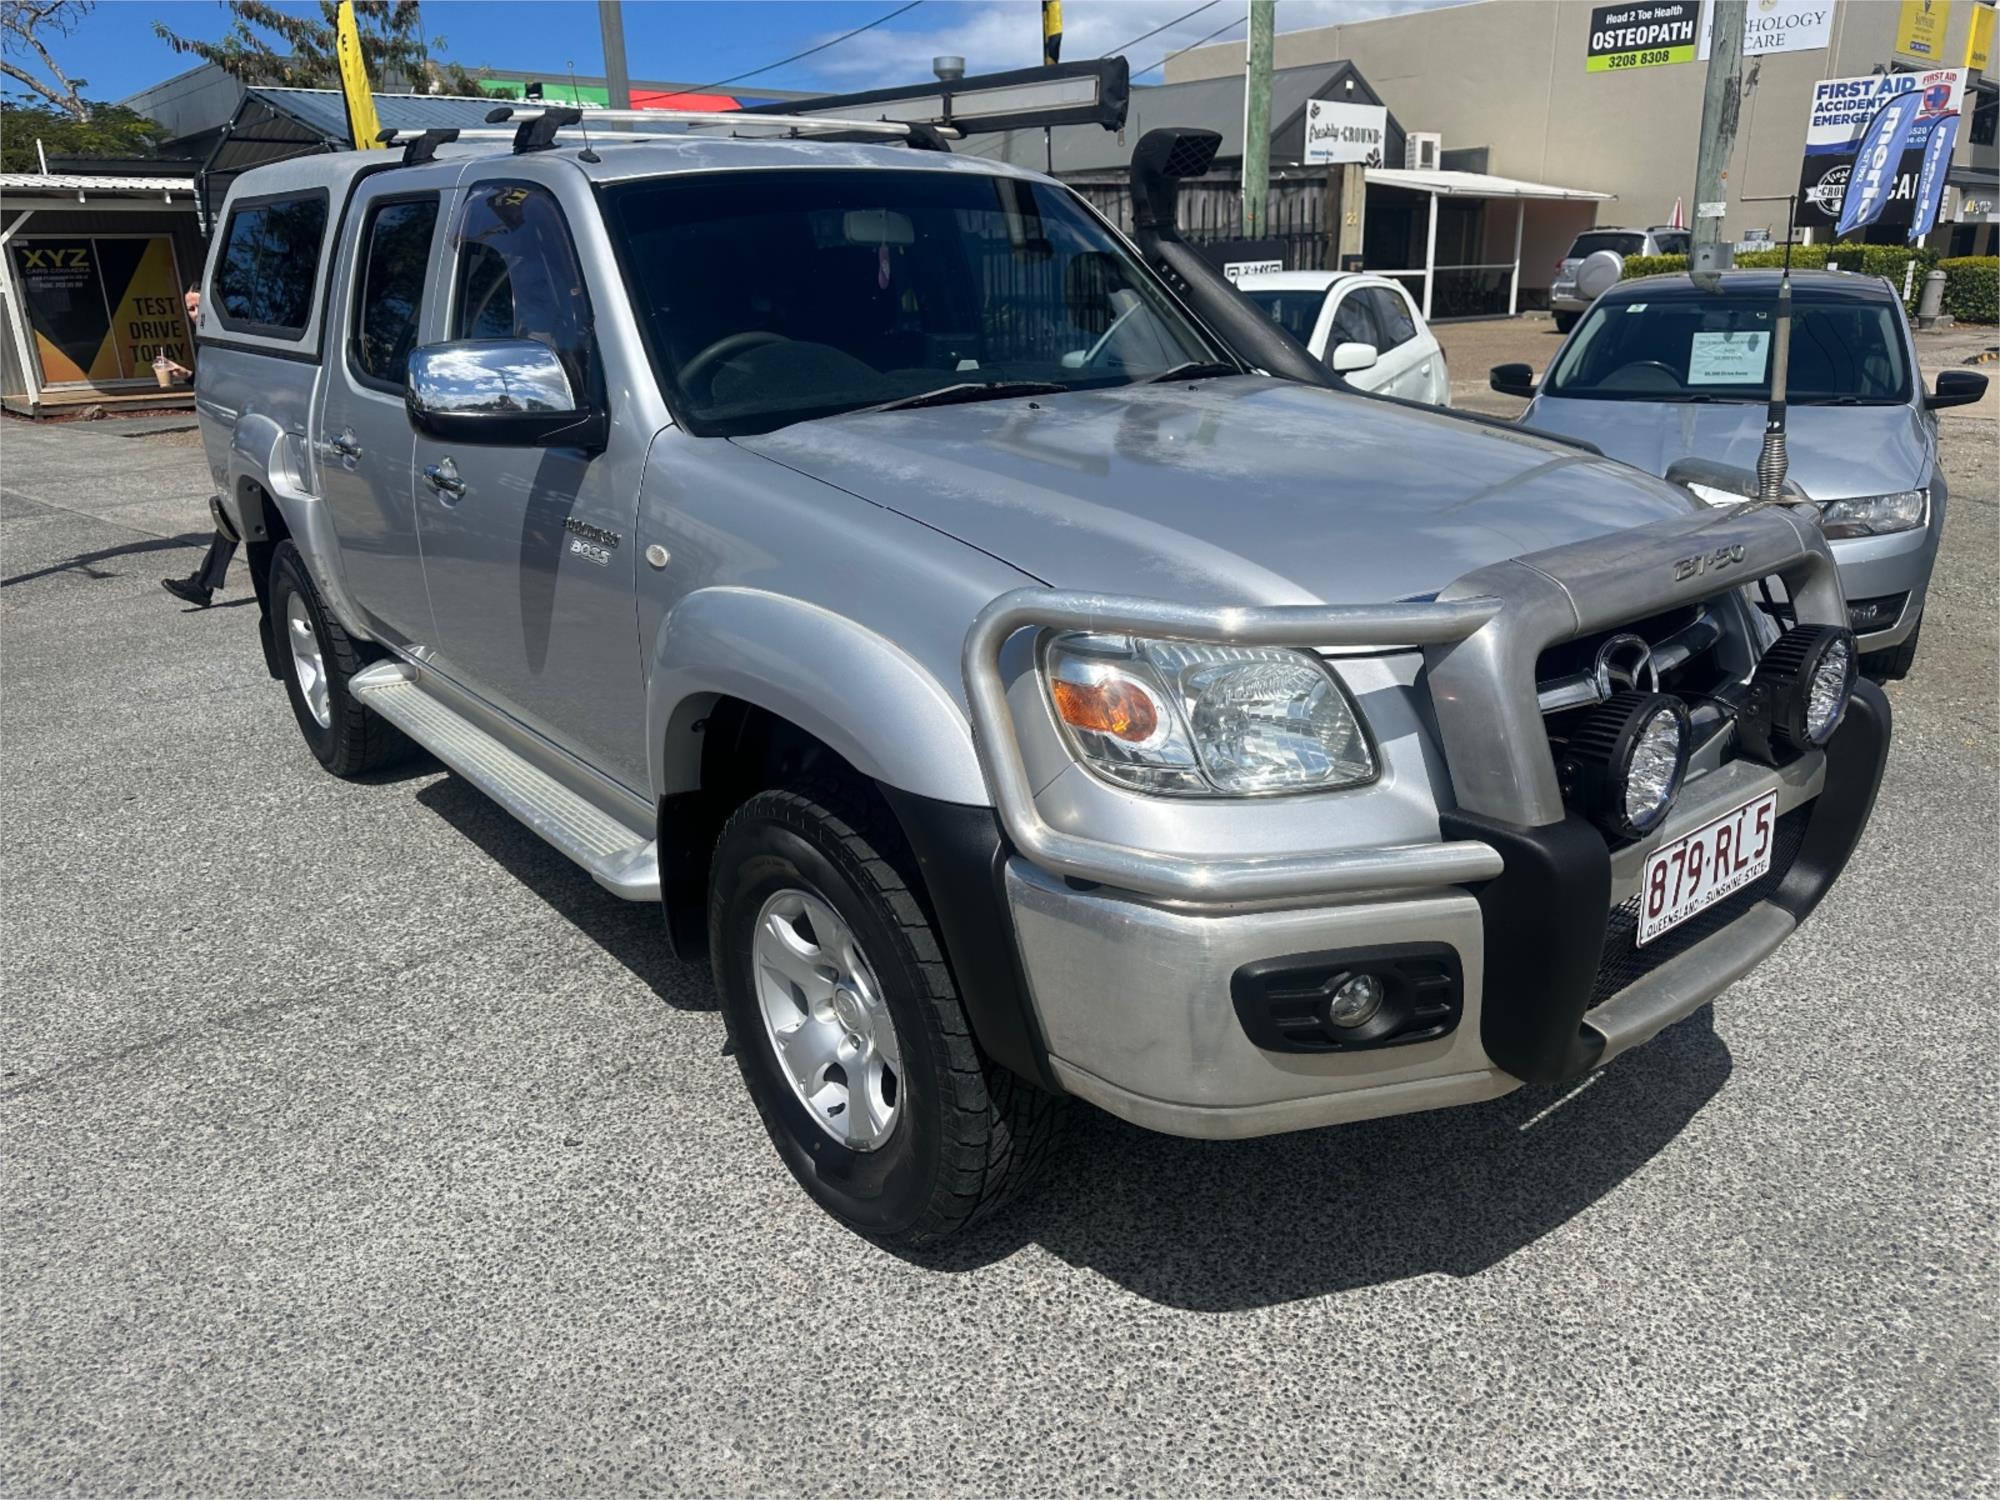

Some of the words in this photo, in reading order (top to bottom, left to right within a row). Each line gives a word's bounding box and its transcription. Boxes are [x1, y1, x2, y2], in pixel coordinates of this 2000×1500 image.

[1605, 12, 1628, 24] Head
[1629, 11, 1636, 21] 2
[1637, 9, 1653, 20] Toe
[1654, 5, 1683, 18] Health
[1592, 20, 1694, 51] OSTEOPATH
[1608, 54, 1637, 68] 3208
[1640, 50, 1670, 64] 8308
[1923, 71, 1944, 84] FIRST
[1945, 71, 1957, 82] AID
[1816, 81, 1875, 101] FIRST
[1878, 77, 1917, 95] AID
[1815, 97, 1886, 114] ACCIDENT
[21, 249, 90, 268] XYZ
[132, 297, 176, 316] TEST
[129, 320, 183, 340] DRIVE
[570, 539, 611, 565] BOSS
[1646, 898, 1698, 938] QUEENSLAND
[1705, 873, 1743, 906] SUNSHINE
[1744, 859, 1767, 883] STATE
